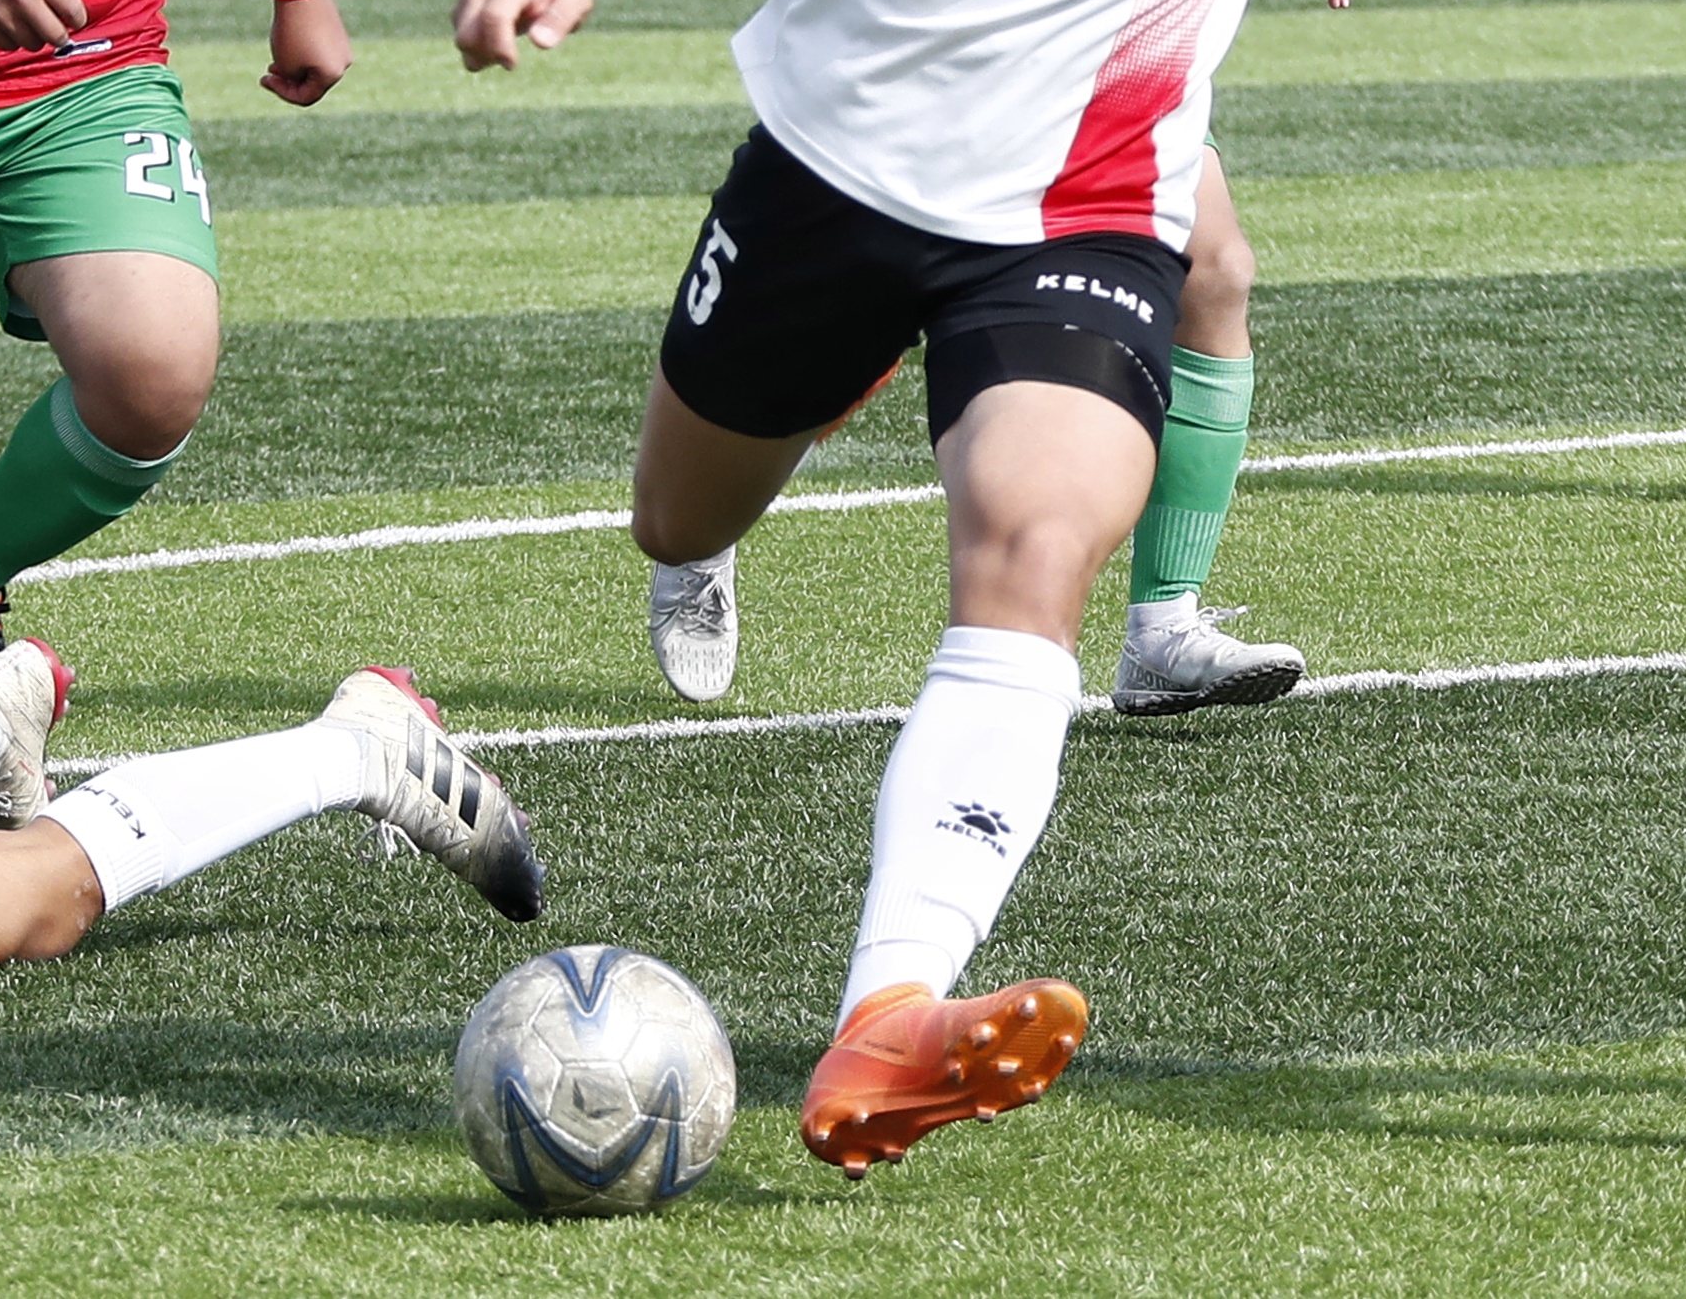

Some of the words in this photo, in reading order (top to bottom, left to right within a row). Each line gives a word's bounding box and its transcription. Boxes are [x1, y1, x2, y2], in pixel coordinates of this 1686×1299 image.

[123, 131, 212, 227] 24
[687, 218, 739, 327] 5
[1036, 274, 1155, 325] KELME
[935, 819, 1007, 858] KELME
